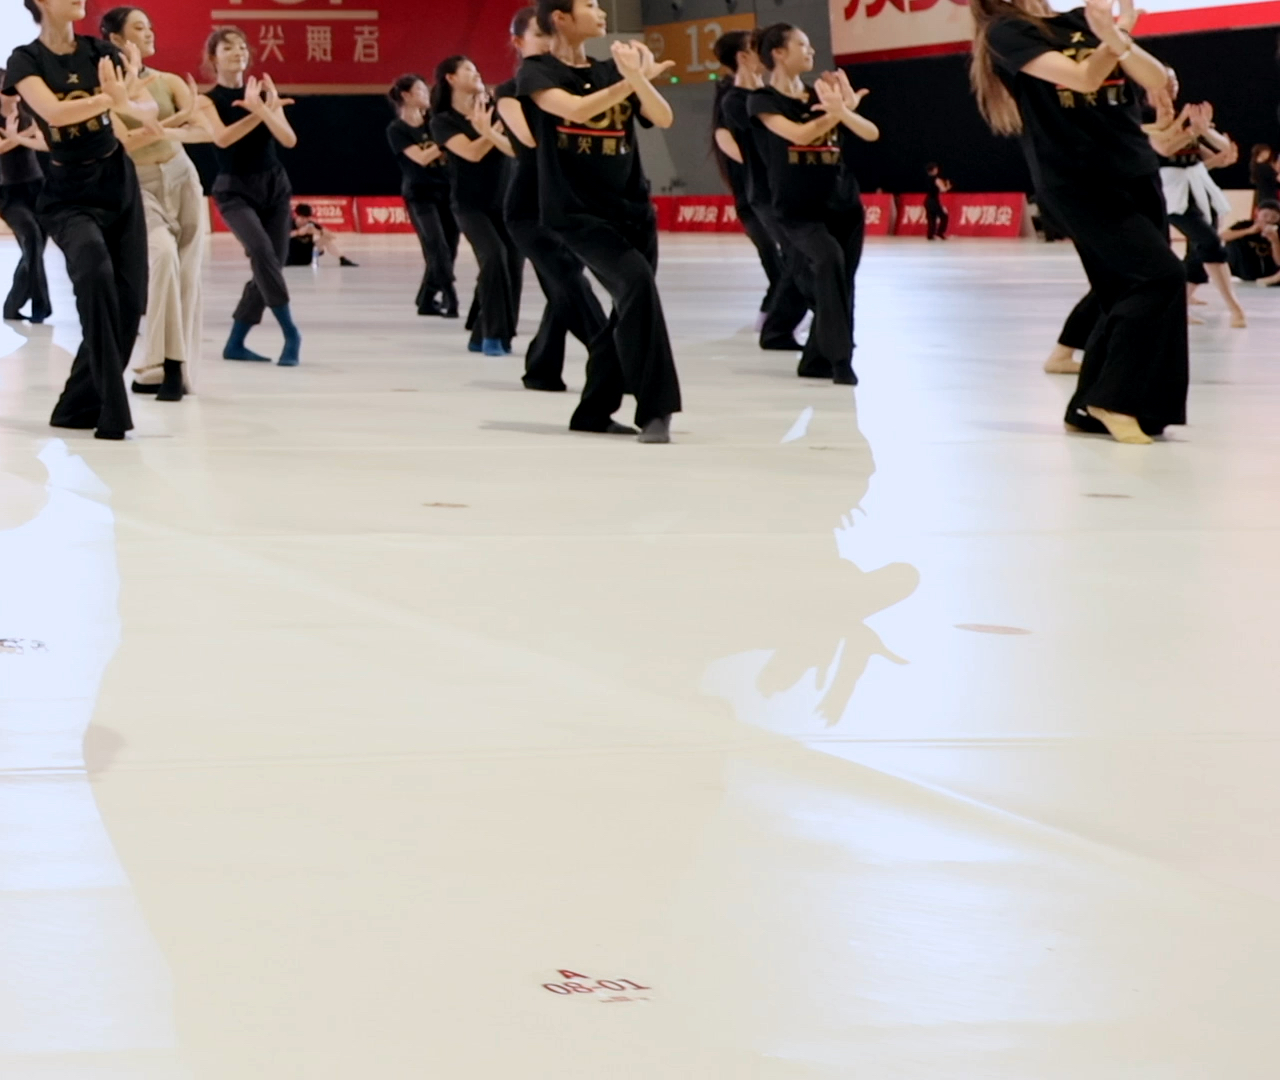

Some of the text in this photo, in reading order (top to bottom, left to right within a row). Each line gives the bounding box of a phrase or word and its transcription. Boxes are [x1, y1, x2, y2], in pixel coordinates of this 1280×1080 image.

[211, 24, 378, 62] 尖舞者
[541, 979, 652, 995] 08-01
